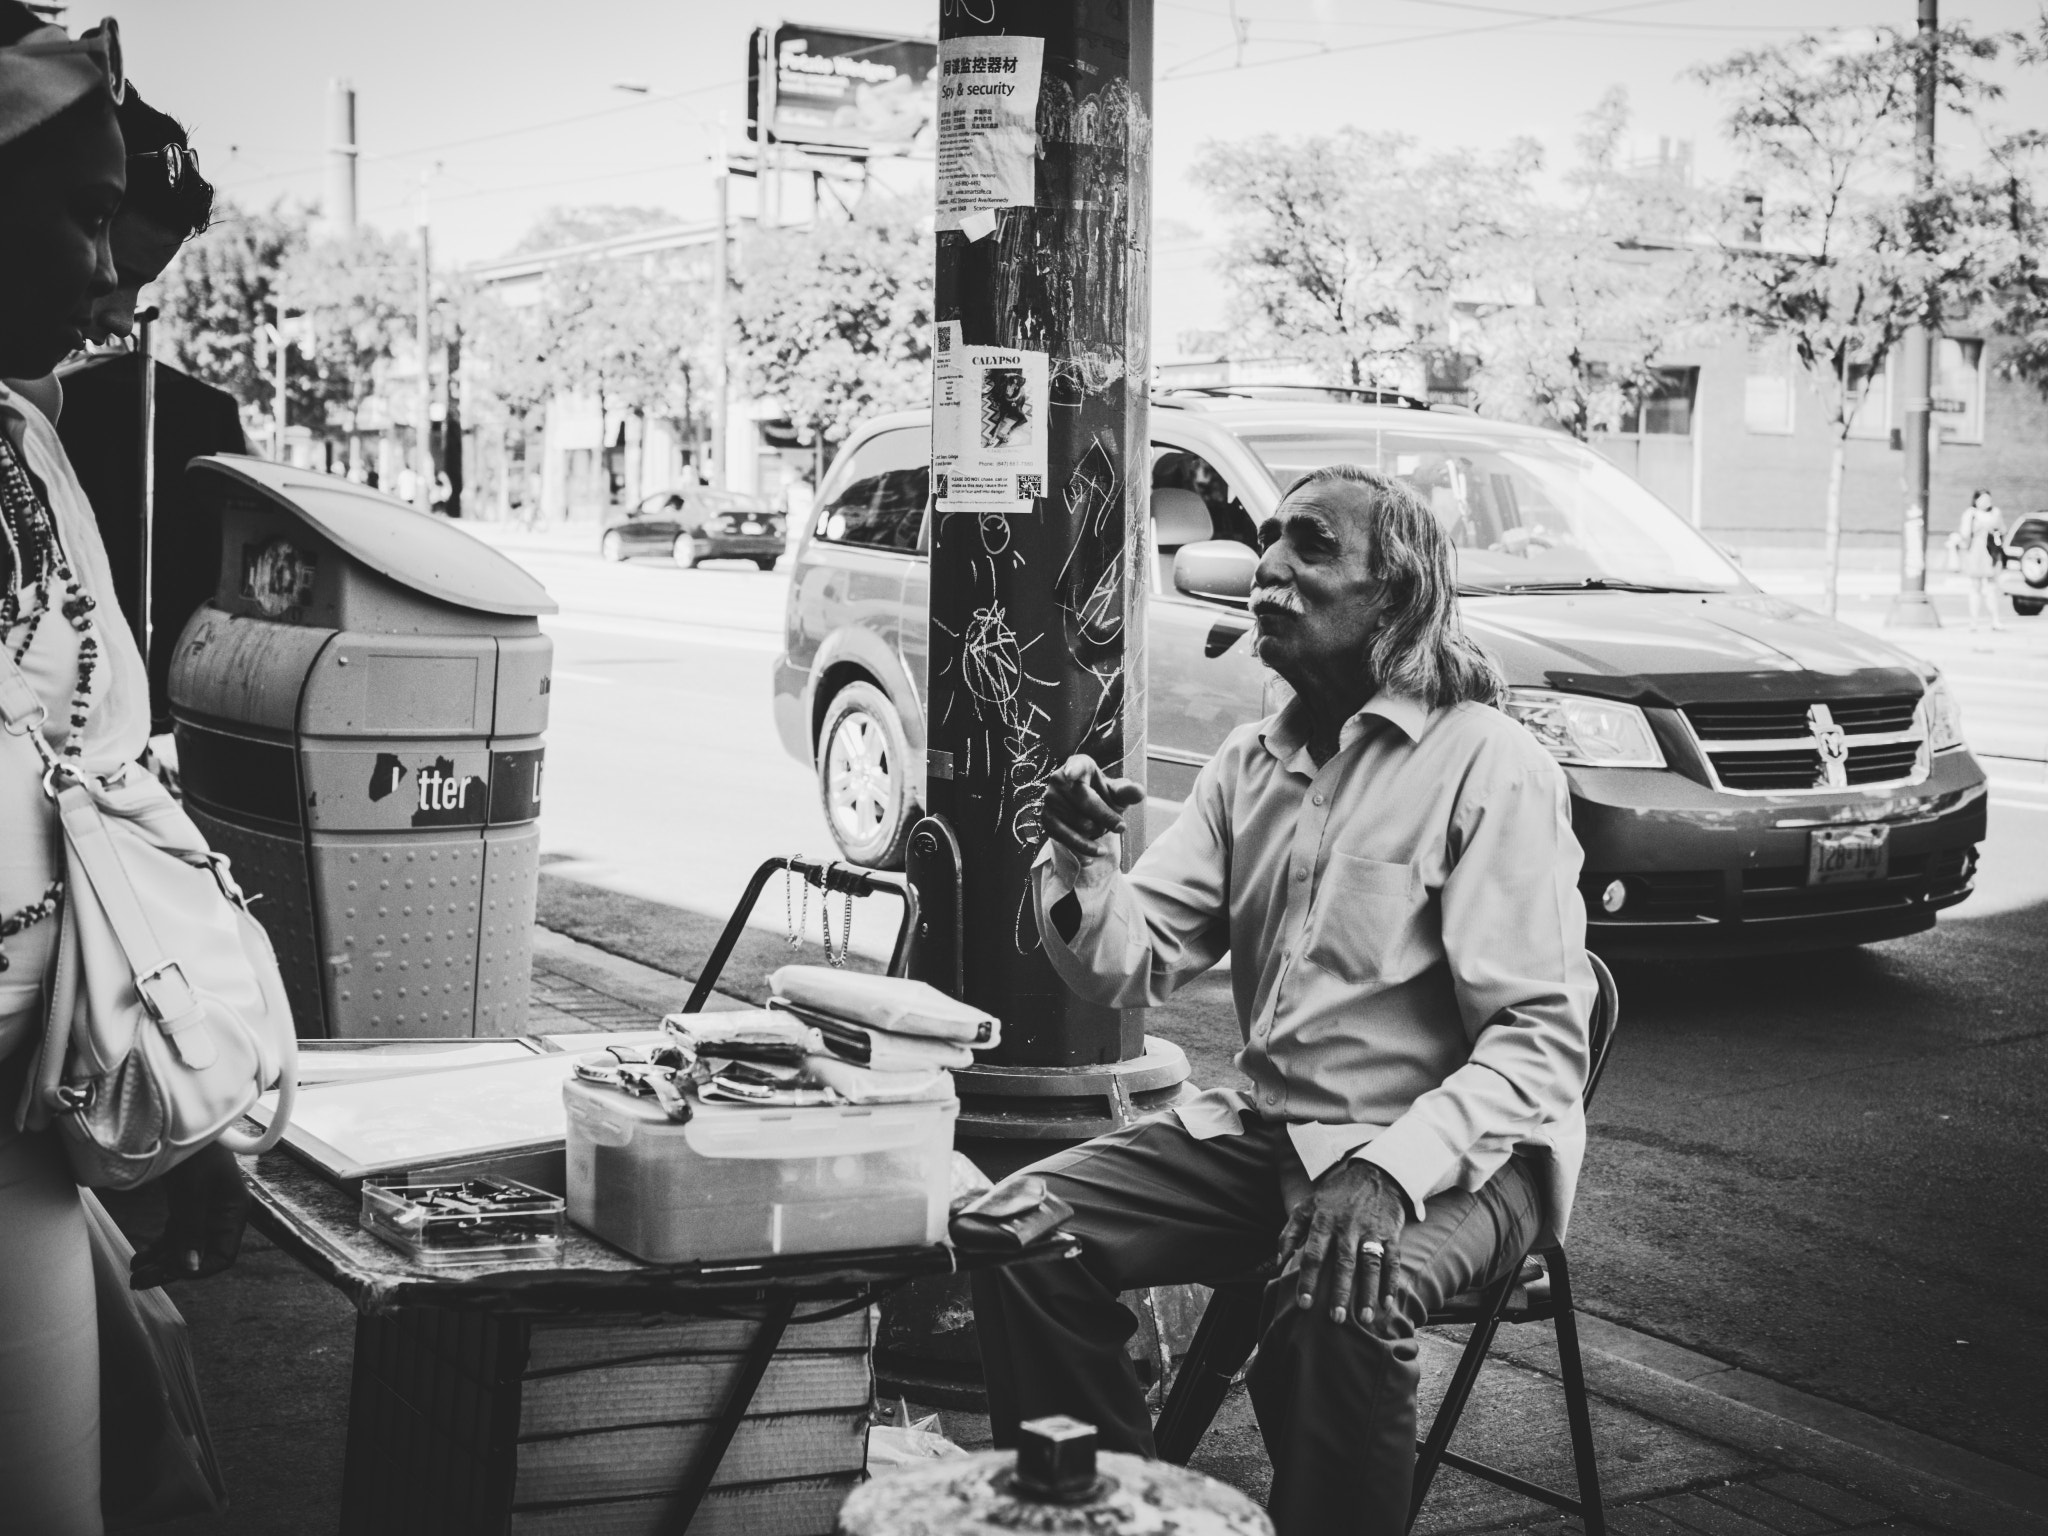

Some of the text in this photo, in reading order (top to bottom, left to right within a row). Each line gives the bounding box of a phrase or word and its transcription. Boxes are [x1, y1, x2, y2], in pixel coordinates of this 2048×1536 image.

[942, 82, 1016, 99] Spy & security
[972, 356, 1021, 365] CALYPSO
